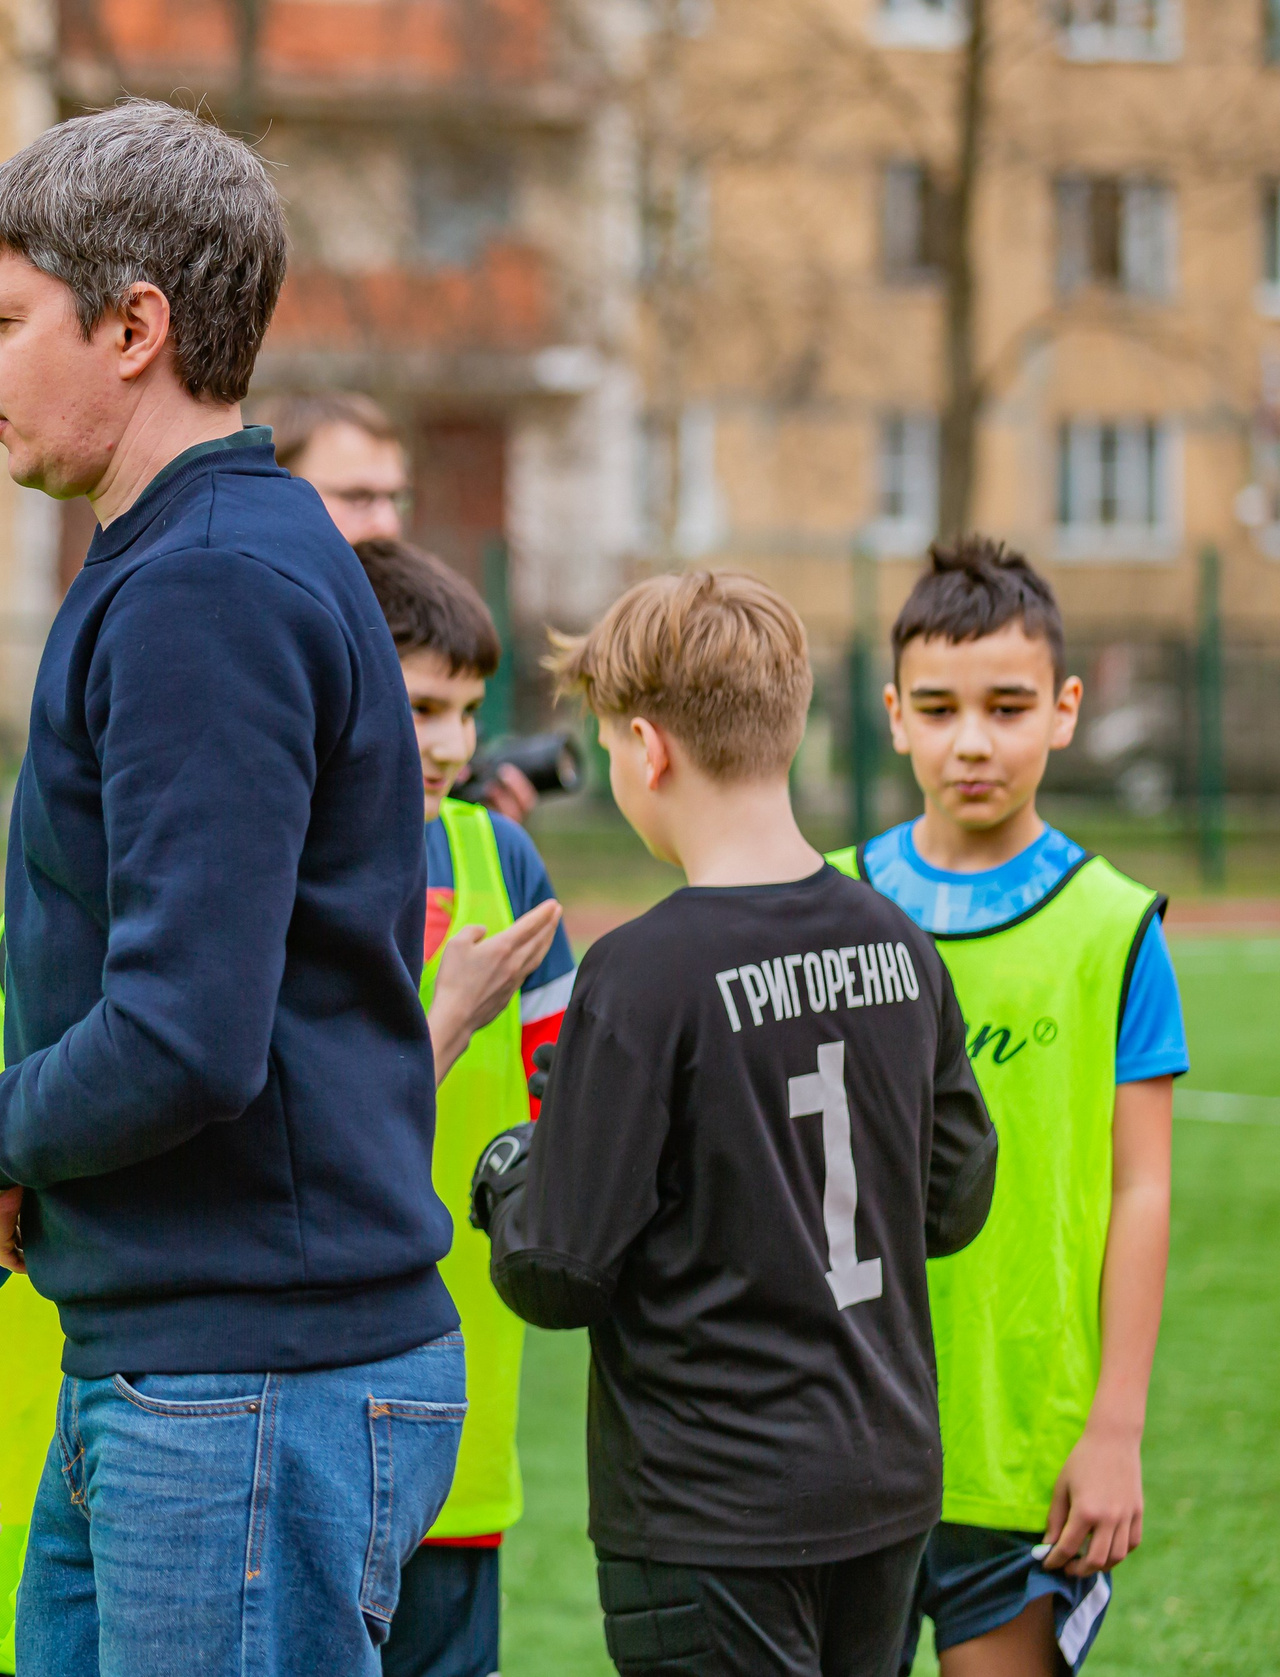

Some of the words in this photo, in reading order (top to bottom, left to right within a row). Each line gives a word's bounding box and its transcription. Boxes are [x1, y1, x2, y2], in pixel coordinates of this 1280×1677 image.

[716, 941, 919, 1032] ГРИГОРЕНКО
[964, 1023, 1027, 1064] n
[788, 1040, 882, 1311] 1
